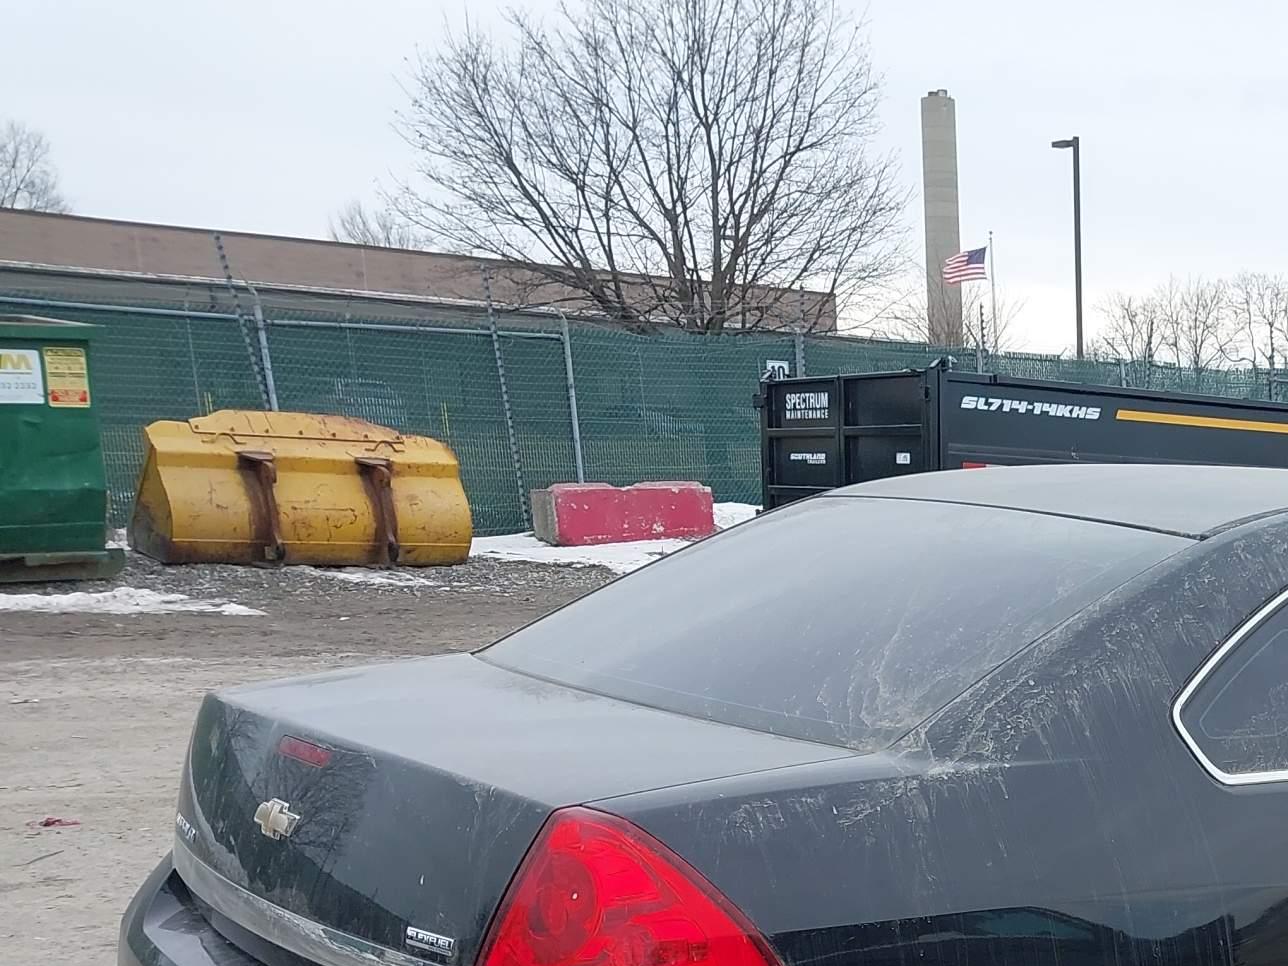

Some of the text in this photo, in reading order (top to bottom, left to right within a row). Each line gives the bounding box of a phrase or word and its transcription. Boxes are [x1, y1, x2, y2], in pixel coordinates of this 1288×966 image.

[786, 392, 828, 409] SPECTRUM
[961, 396, 1101, 419] SL714-14KHS
[786, 409, 828, 419] MAINTENANCE
